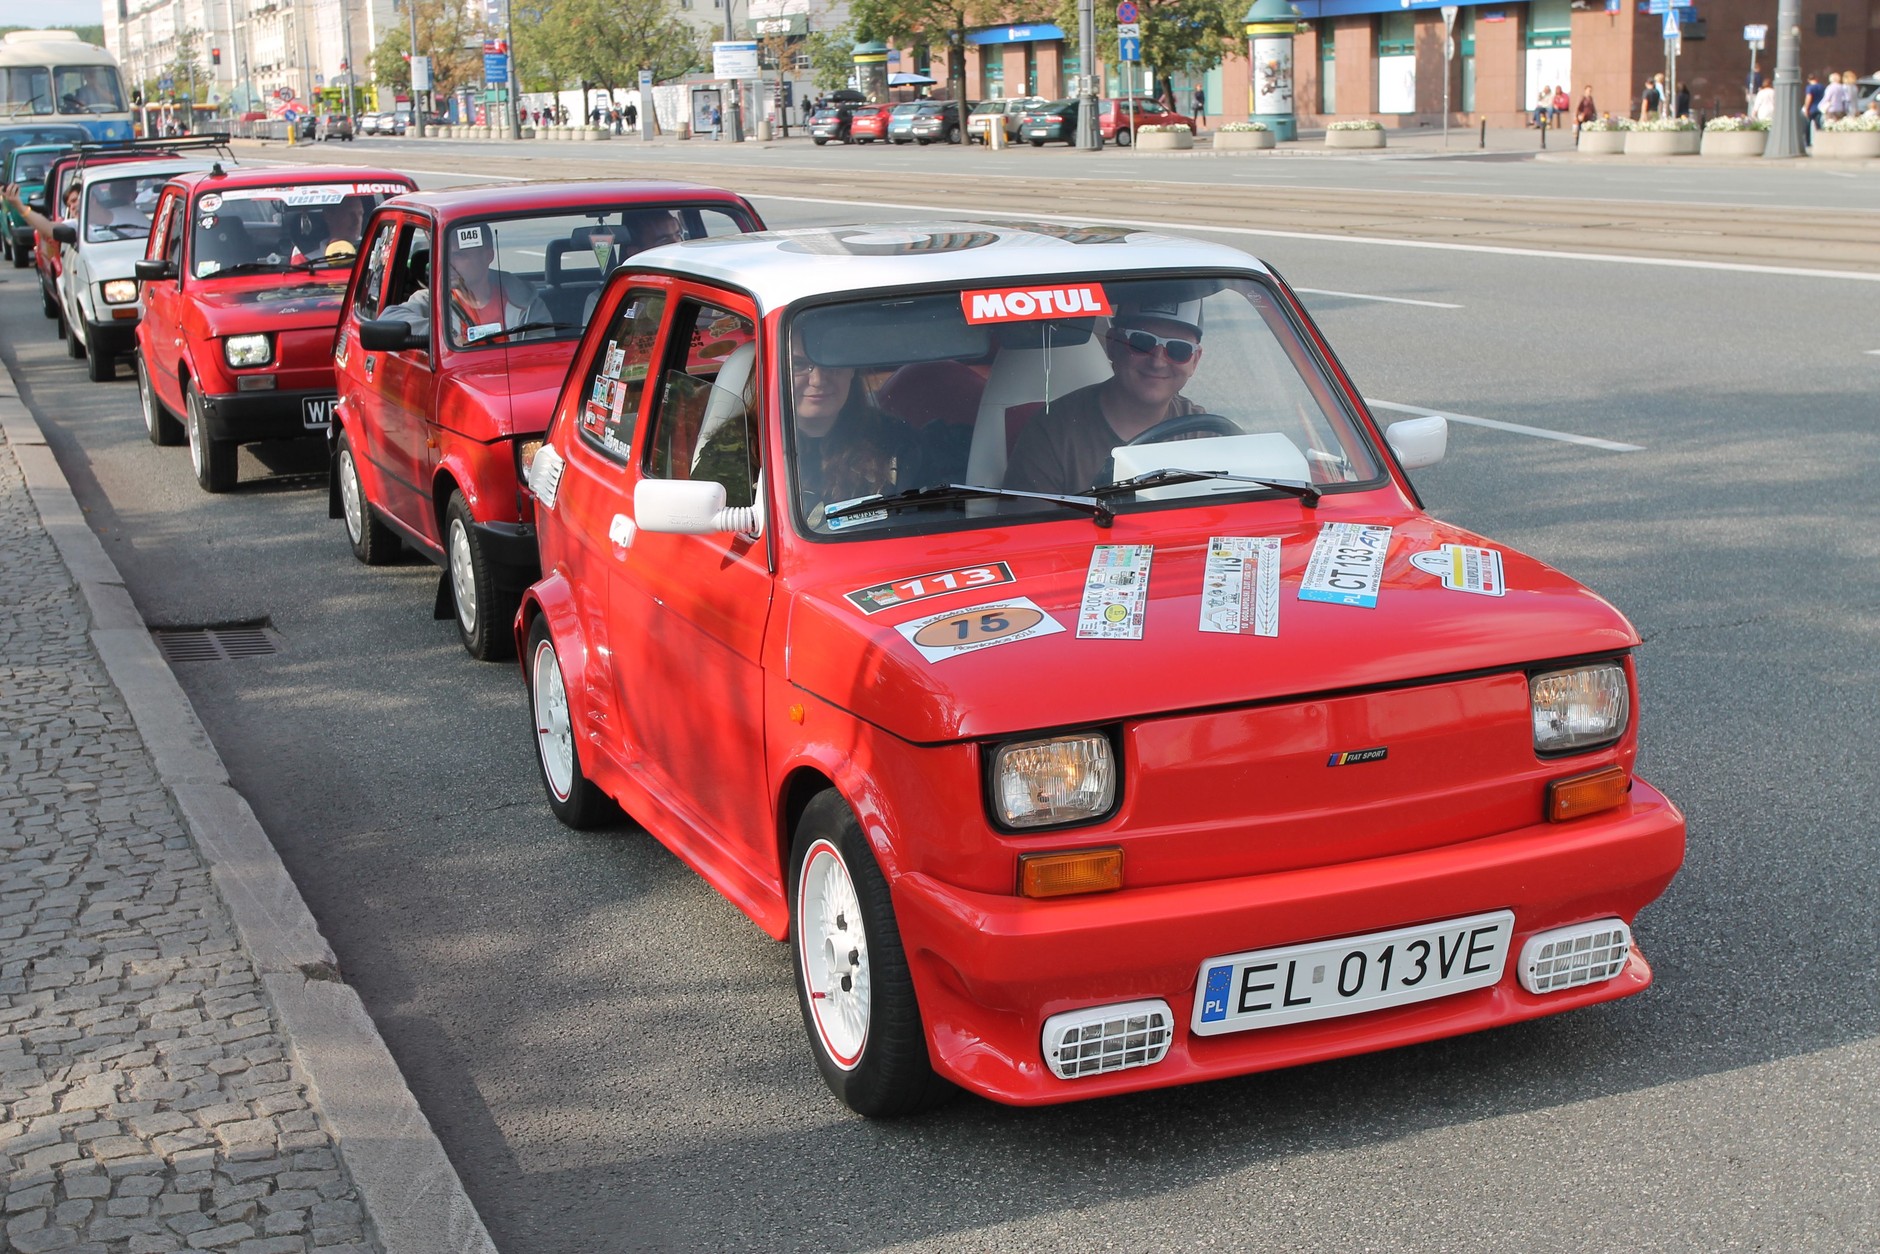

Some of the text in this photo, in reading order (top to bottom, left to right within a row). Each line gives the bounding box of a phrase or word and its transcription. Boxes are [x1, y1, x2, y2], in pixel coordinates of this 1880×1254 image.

[357, 184, 408, 194] MOTUL
[288, 194, 343, 204] verva
[461, 230, 478, 241] 046
[972, 288, 1102, 319] MOTUL
[1209, 558, 1242, 574] 113
[1328, 548, 1374, 590] CT 133
[900, 568, 996, 596] 113
[1343, 594, 1360, 604] PL
[950, 612, 1010, 640] 15
[1347, 750, 1386, 762] FIAT SPORT
[1237, 925, 1499, 1014] EL 013VE
[1205, 1000, 1224, 1015] PL
